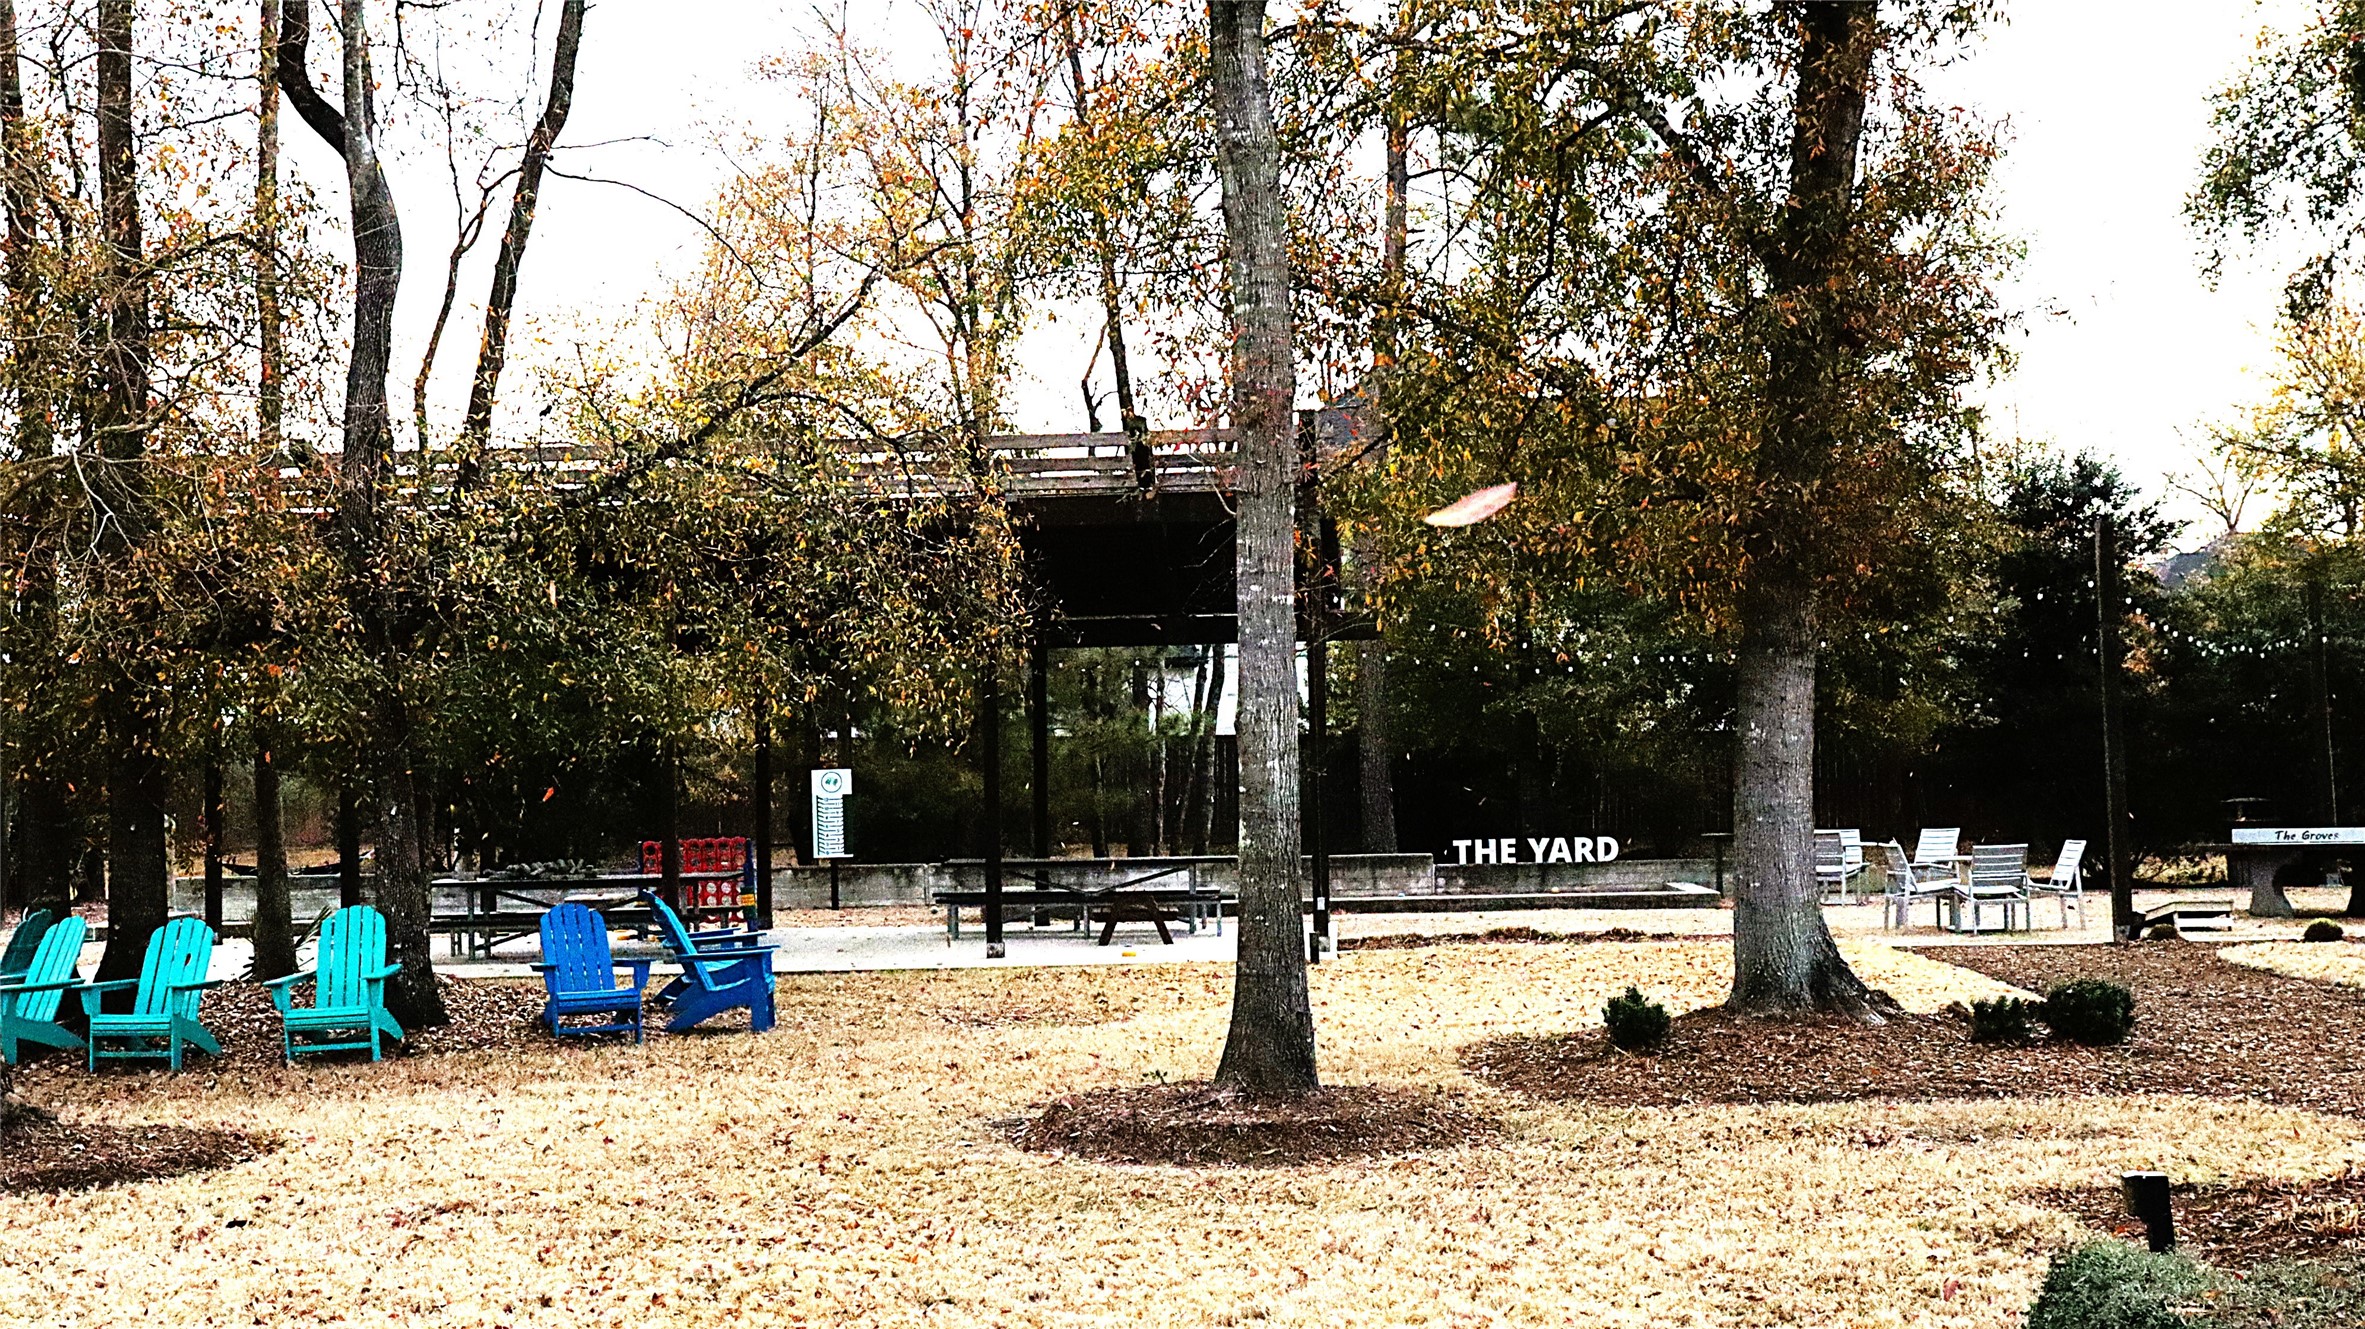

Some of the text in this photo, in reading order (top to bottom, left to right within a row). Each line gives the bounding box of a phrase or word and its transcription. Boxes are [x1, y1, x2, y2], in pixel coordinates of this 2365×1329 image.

[2275, 830, 2339, 840] The Groves
[1453, 836, 1619, 865] THE YARD
